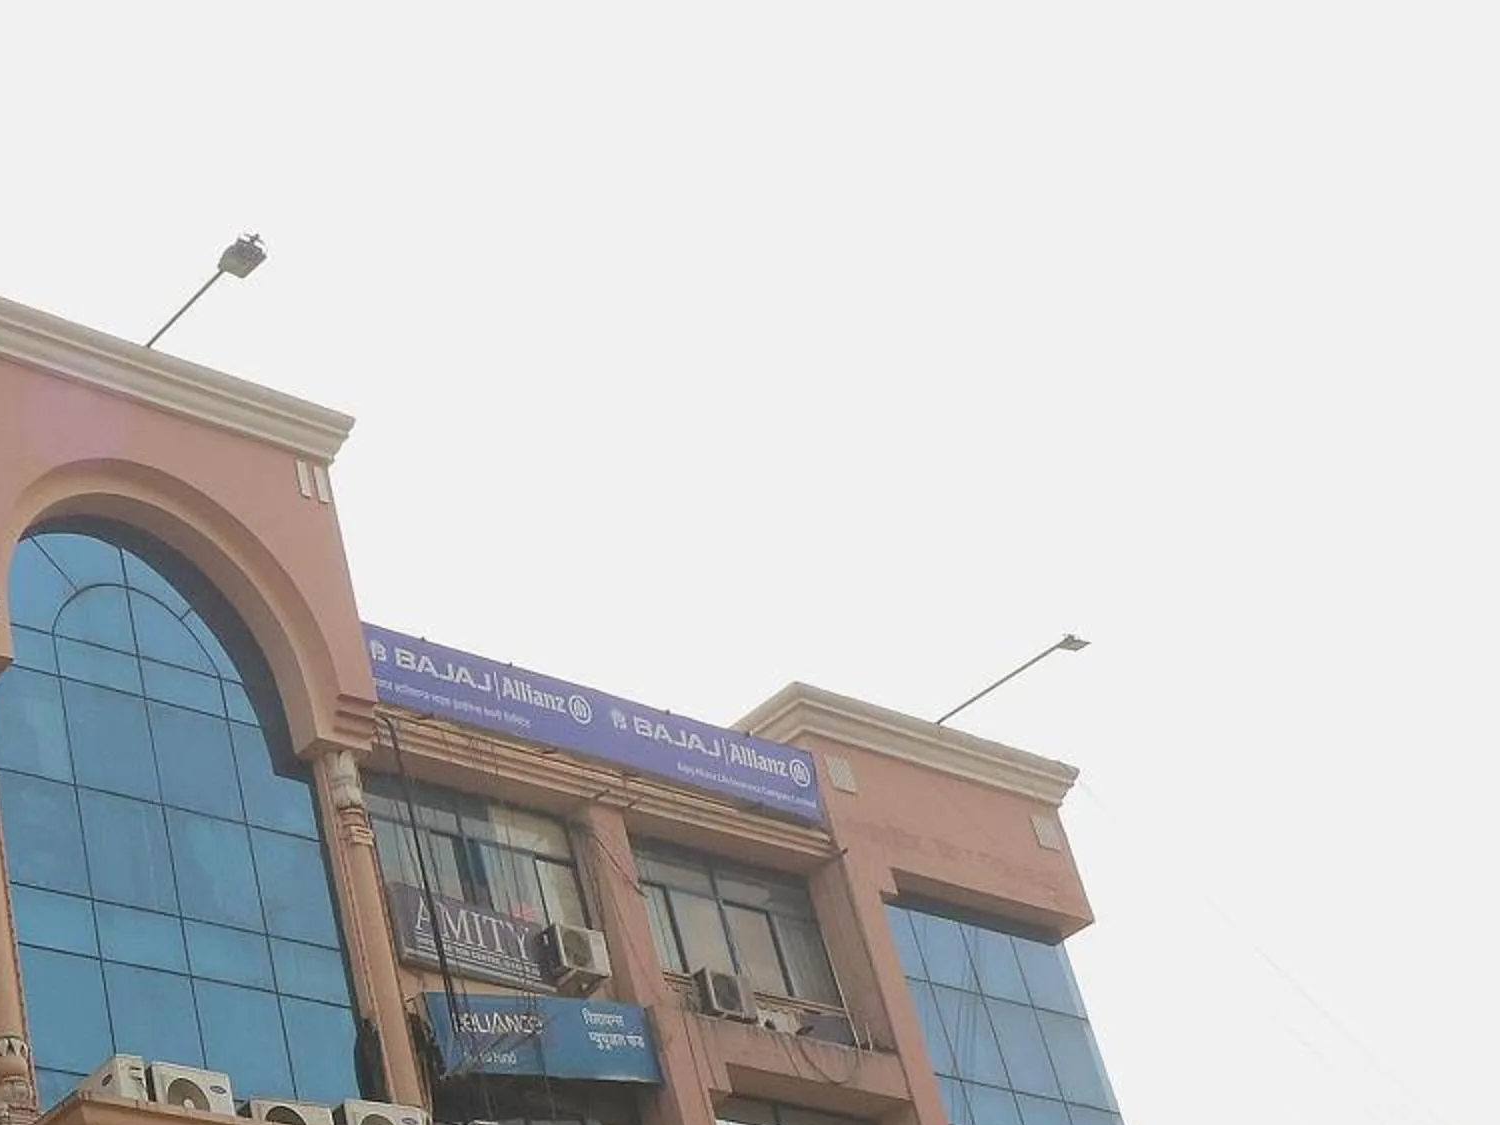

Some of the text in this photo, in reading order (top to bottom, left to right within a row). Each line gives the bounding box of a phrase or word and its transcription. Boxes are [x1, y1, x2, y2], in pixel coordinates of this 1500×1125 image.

[395, 648, 492, 692] BAJAJ
[502, 677, 567, 713] Allianz
[633, 715, 790, 777] BAJAJ Allianz
[415, 896, 529, 961] AMITY
